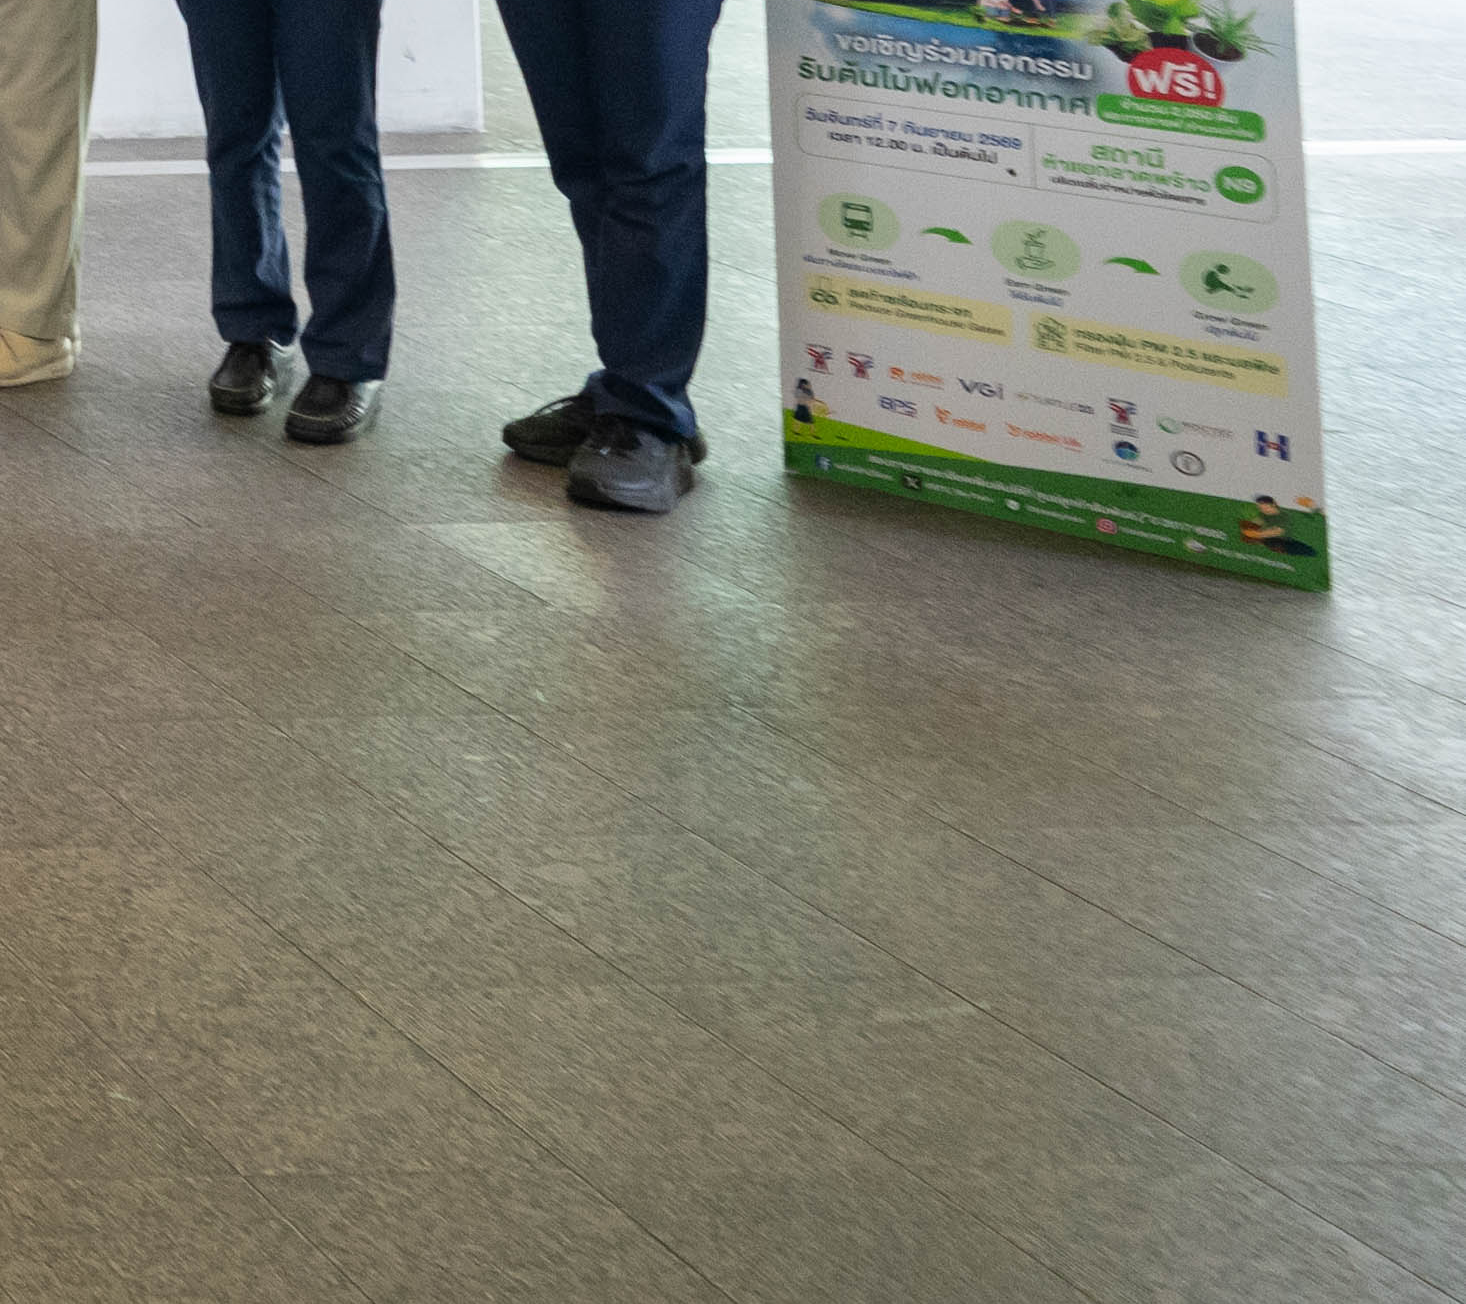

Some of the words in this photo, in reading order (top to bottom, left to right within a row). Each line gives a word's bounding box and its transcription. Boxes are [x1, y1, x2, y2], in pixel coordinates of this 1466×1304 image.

[833, 32, 1095, 82] ขอเชิญร่วมกิจกรรม
[1133, 60, 1217, 100] ฟรี!
[797, 54, 1094, 117] รับต้นไม้ฟอกอากาศ
